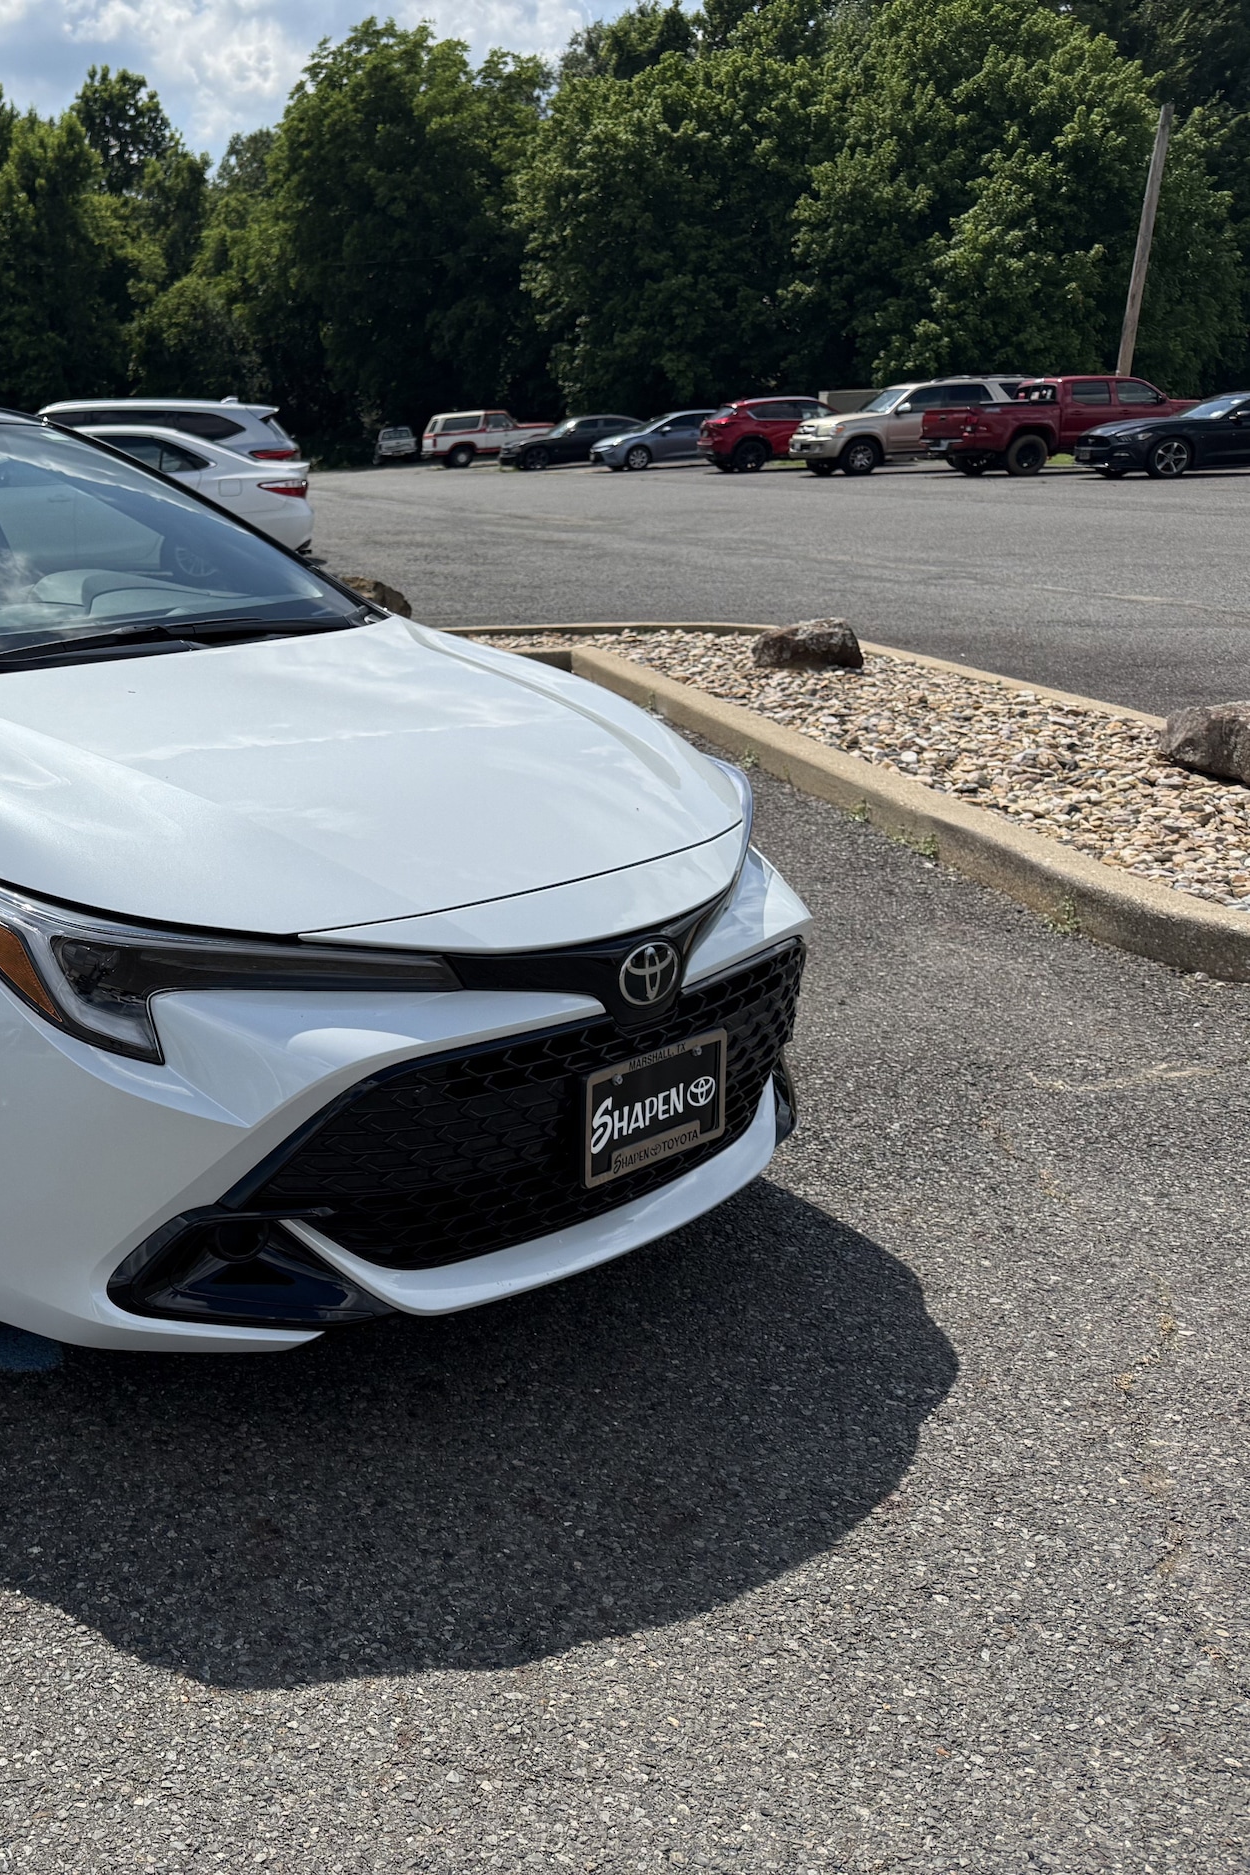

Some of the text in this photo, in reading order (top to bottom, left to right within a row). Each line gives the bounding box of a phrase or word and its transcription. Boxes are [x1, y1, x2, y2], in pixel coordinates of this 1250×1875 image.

[629, 1043, 686, 1071] MARSHALL, TX
[590, 1082, 684, 1155] SHAPEN
[613, 1129, 699, 1174] SHAPEN TOYOTA
